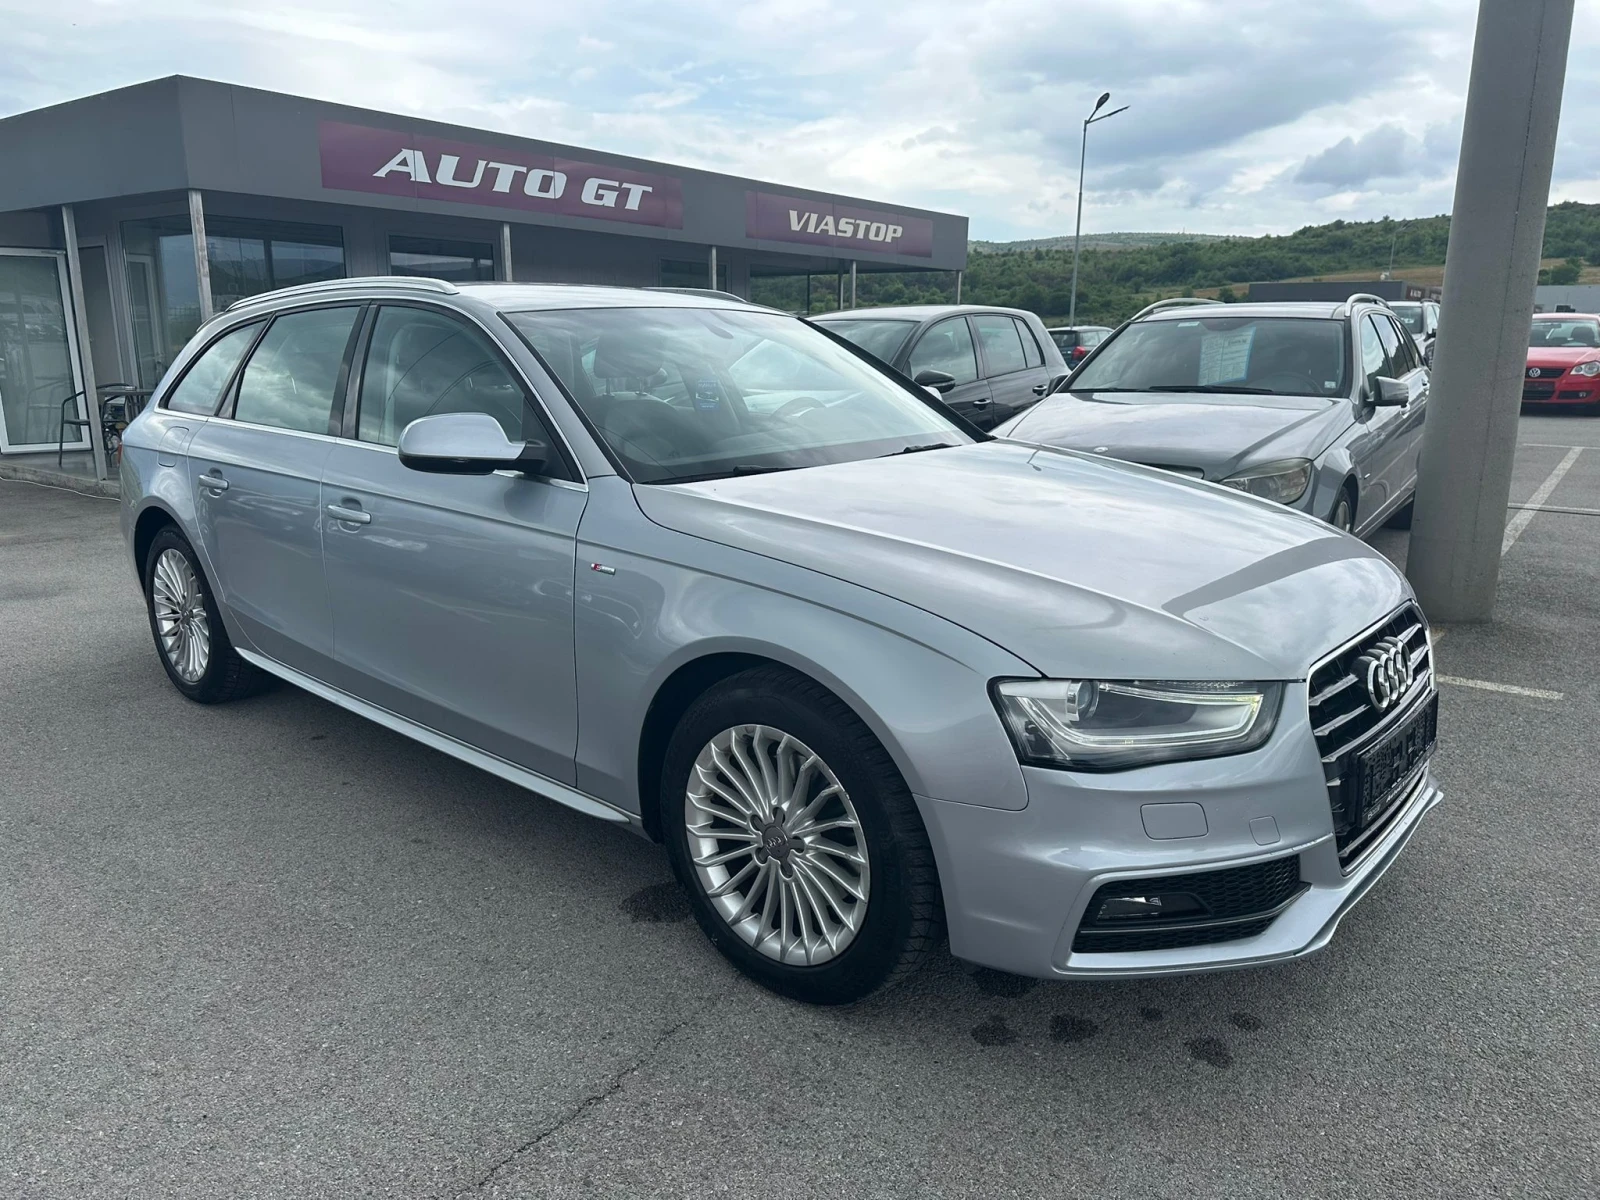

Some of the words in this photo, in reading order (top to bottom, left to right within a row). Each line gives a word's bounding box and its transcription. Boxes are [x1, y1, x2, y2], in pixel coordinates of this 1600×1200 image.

[372, 148, 568, 200] AUTO
[580, 177, 653, 211] GT
[788, 209, 904, 243] VIASTOP
